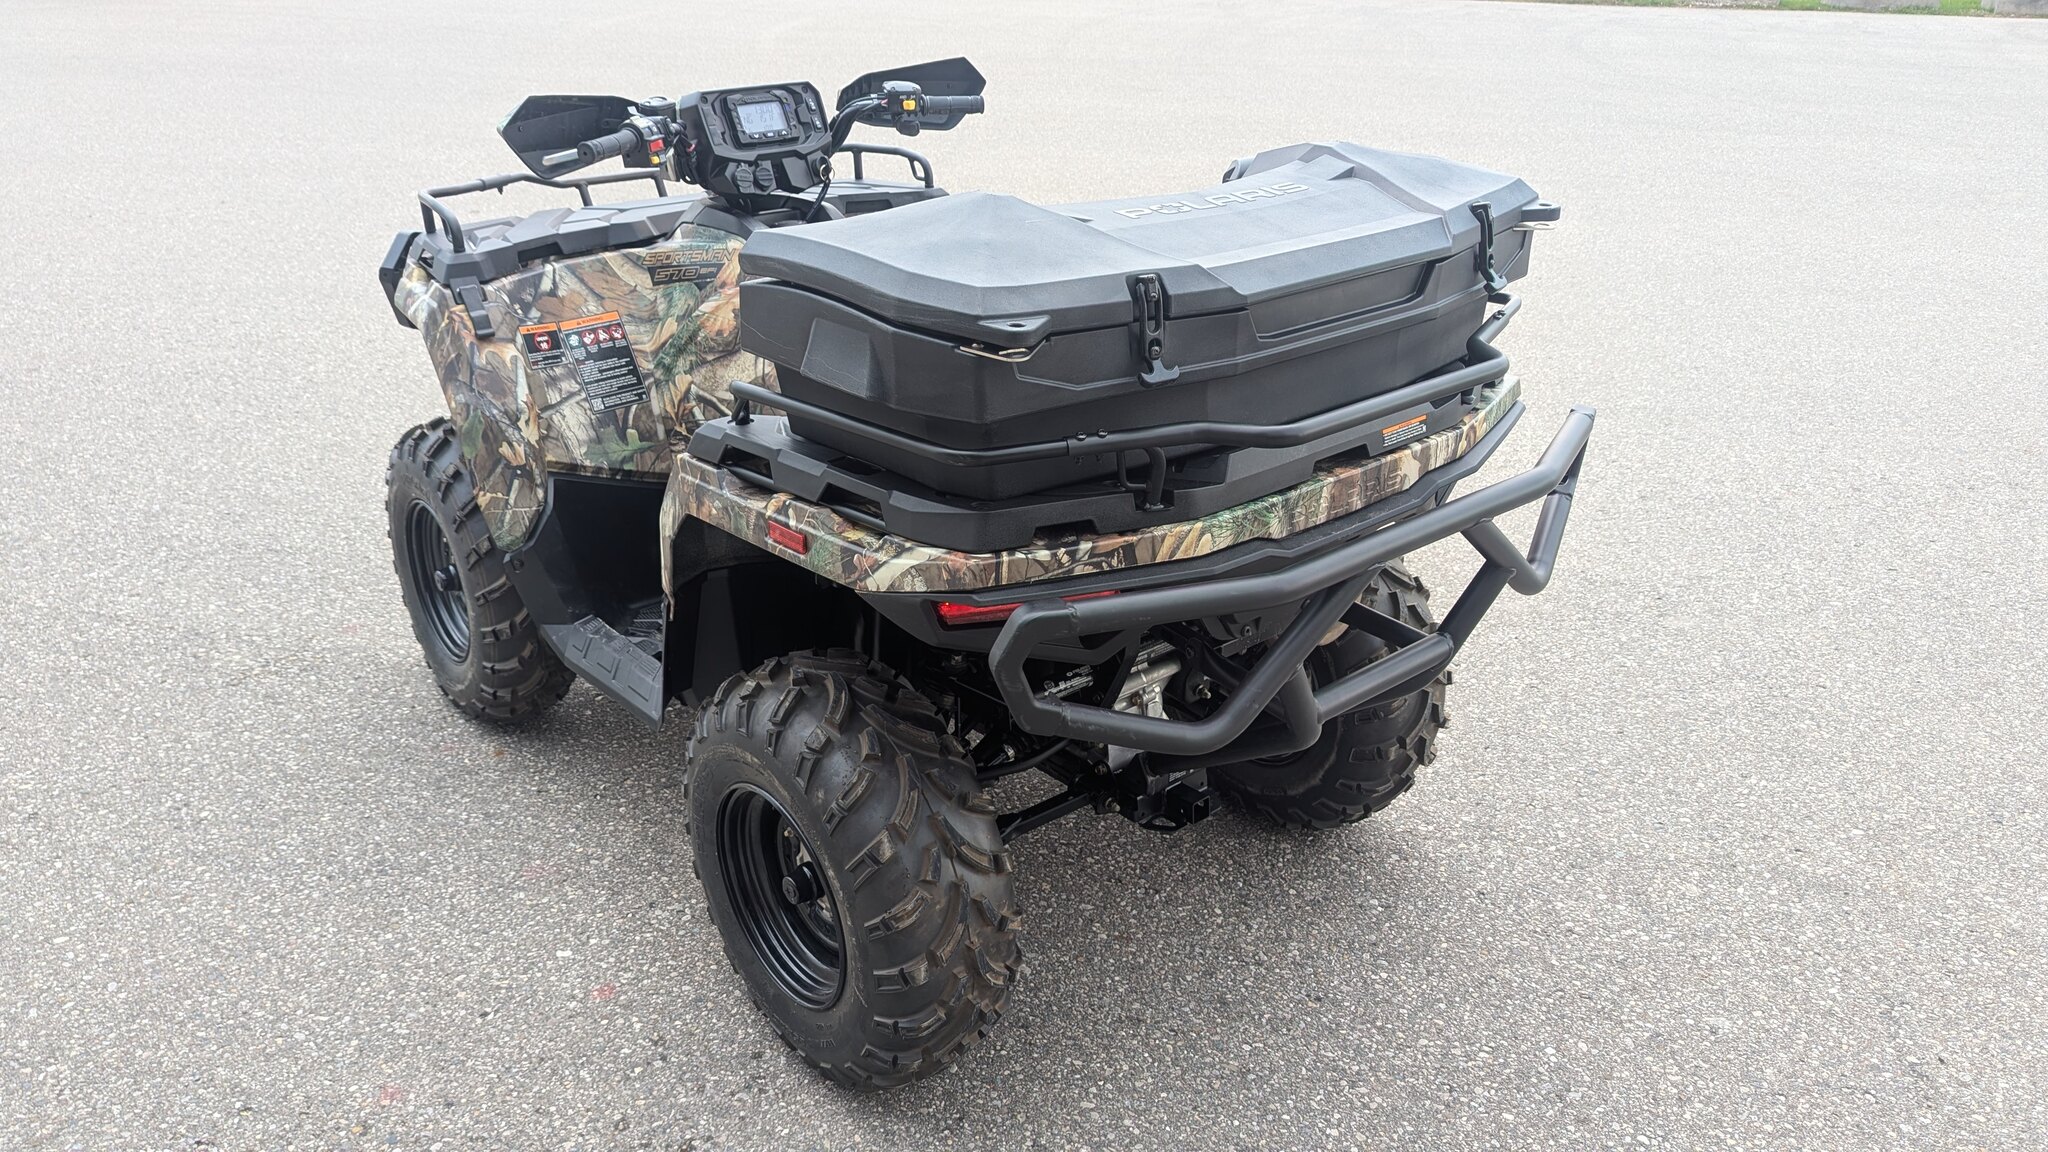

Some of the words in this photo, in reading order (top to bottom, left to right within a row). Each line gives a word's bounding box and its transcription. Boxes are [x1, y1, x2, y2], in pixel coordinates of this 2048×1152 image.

[1113, 182, 1311, 219] POLARIS
[642, 248, 736, 265] SPORTSMAN
[654, 266, 700, 281] 570
